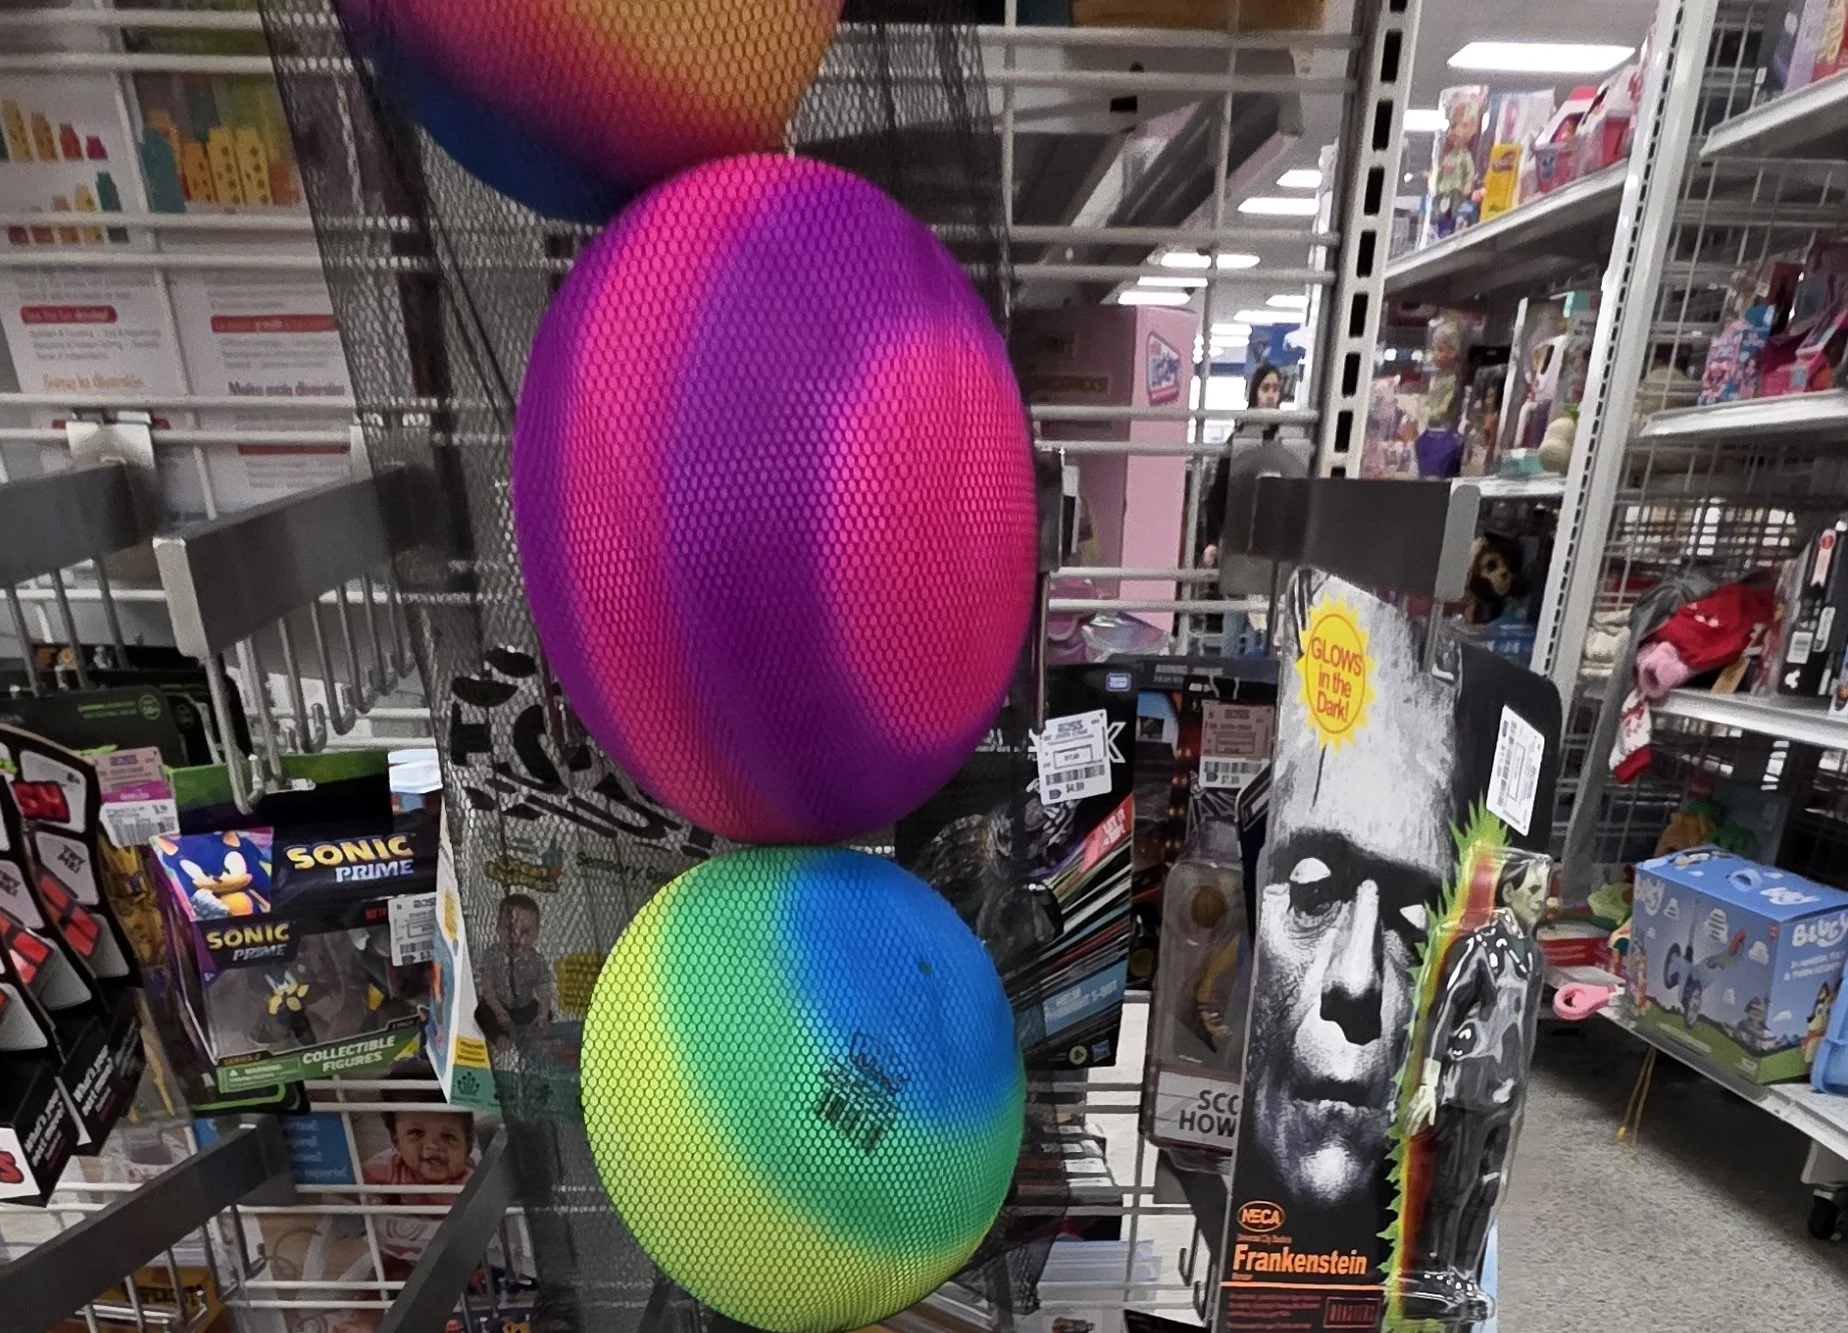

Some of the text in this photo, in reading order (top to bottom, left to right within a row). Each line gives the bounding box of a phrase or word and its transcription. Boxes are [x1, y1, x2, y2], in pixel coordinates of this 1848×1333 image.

[1311, 636, 1364, 677] GLOWS
[1318, 664, 1352, 699] in the
[1316, 690, 1350, 723] Dark!
[286, 834, 415, 870] SONIC
[335, 859, 415, 883] PRIME
[206, 923, 290, 950] SONIC
[232, 944, 288, 962] PRIME
[302, 1035, 396, 1064] COLLECTIBLE
[322, 1051, 383, 1072] FIGURES
[1179, 1109, 1237, 1137] HOW
[1241, 1208, 1281, 1224] NECA
[1232, 1244, 1368, 1275] Frankenstein
